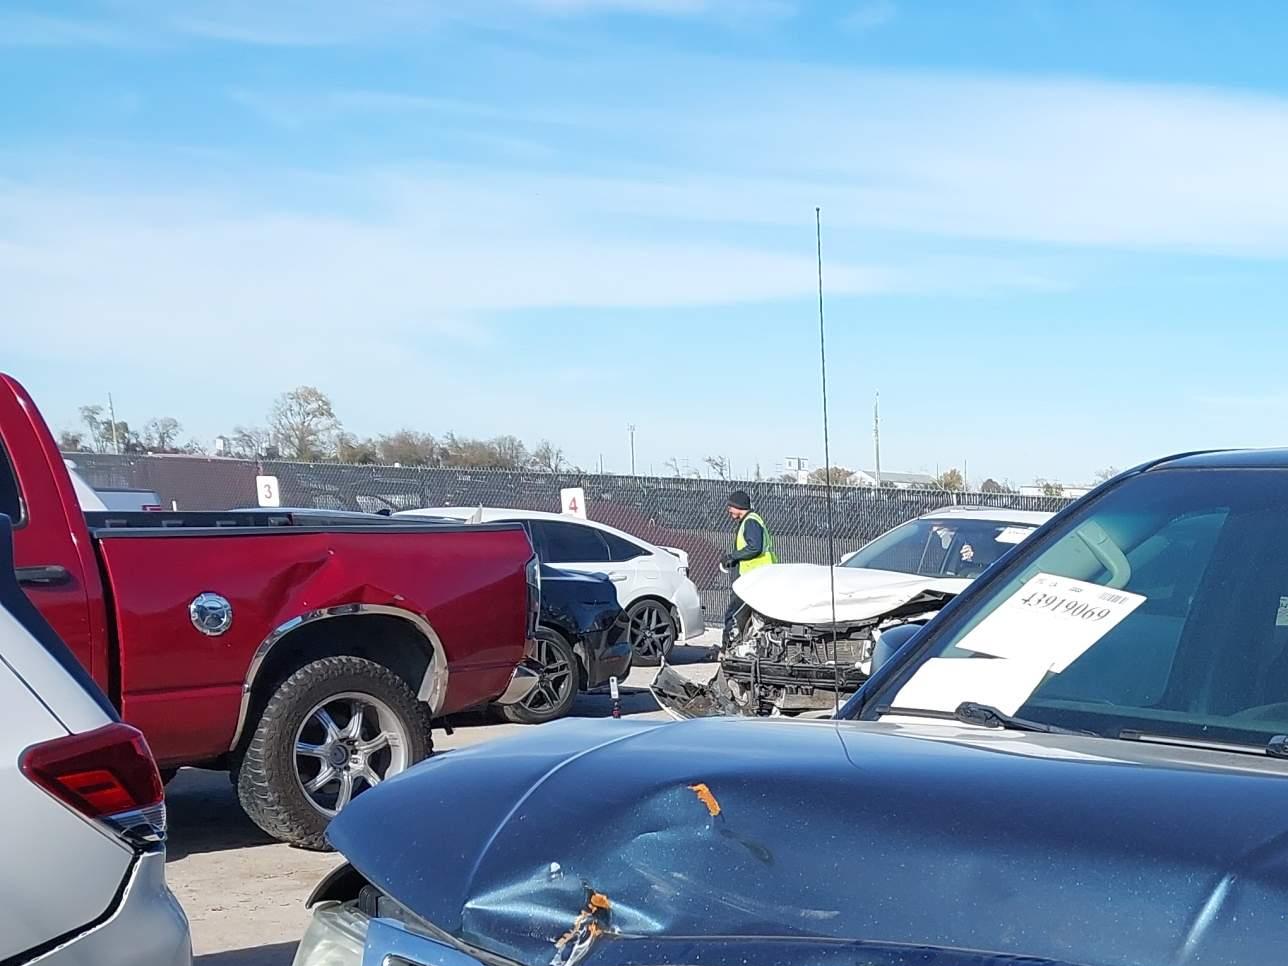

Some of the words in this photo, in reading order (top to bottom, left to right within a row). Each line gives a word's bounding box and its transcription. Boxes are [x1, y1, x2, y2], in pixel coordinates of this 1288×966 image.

[263, 483, 273, 500] 3
[568, 496, 579, 513] 4
[1021, 592, 1111, 622] 43919069
